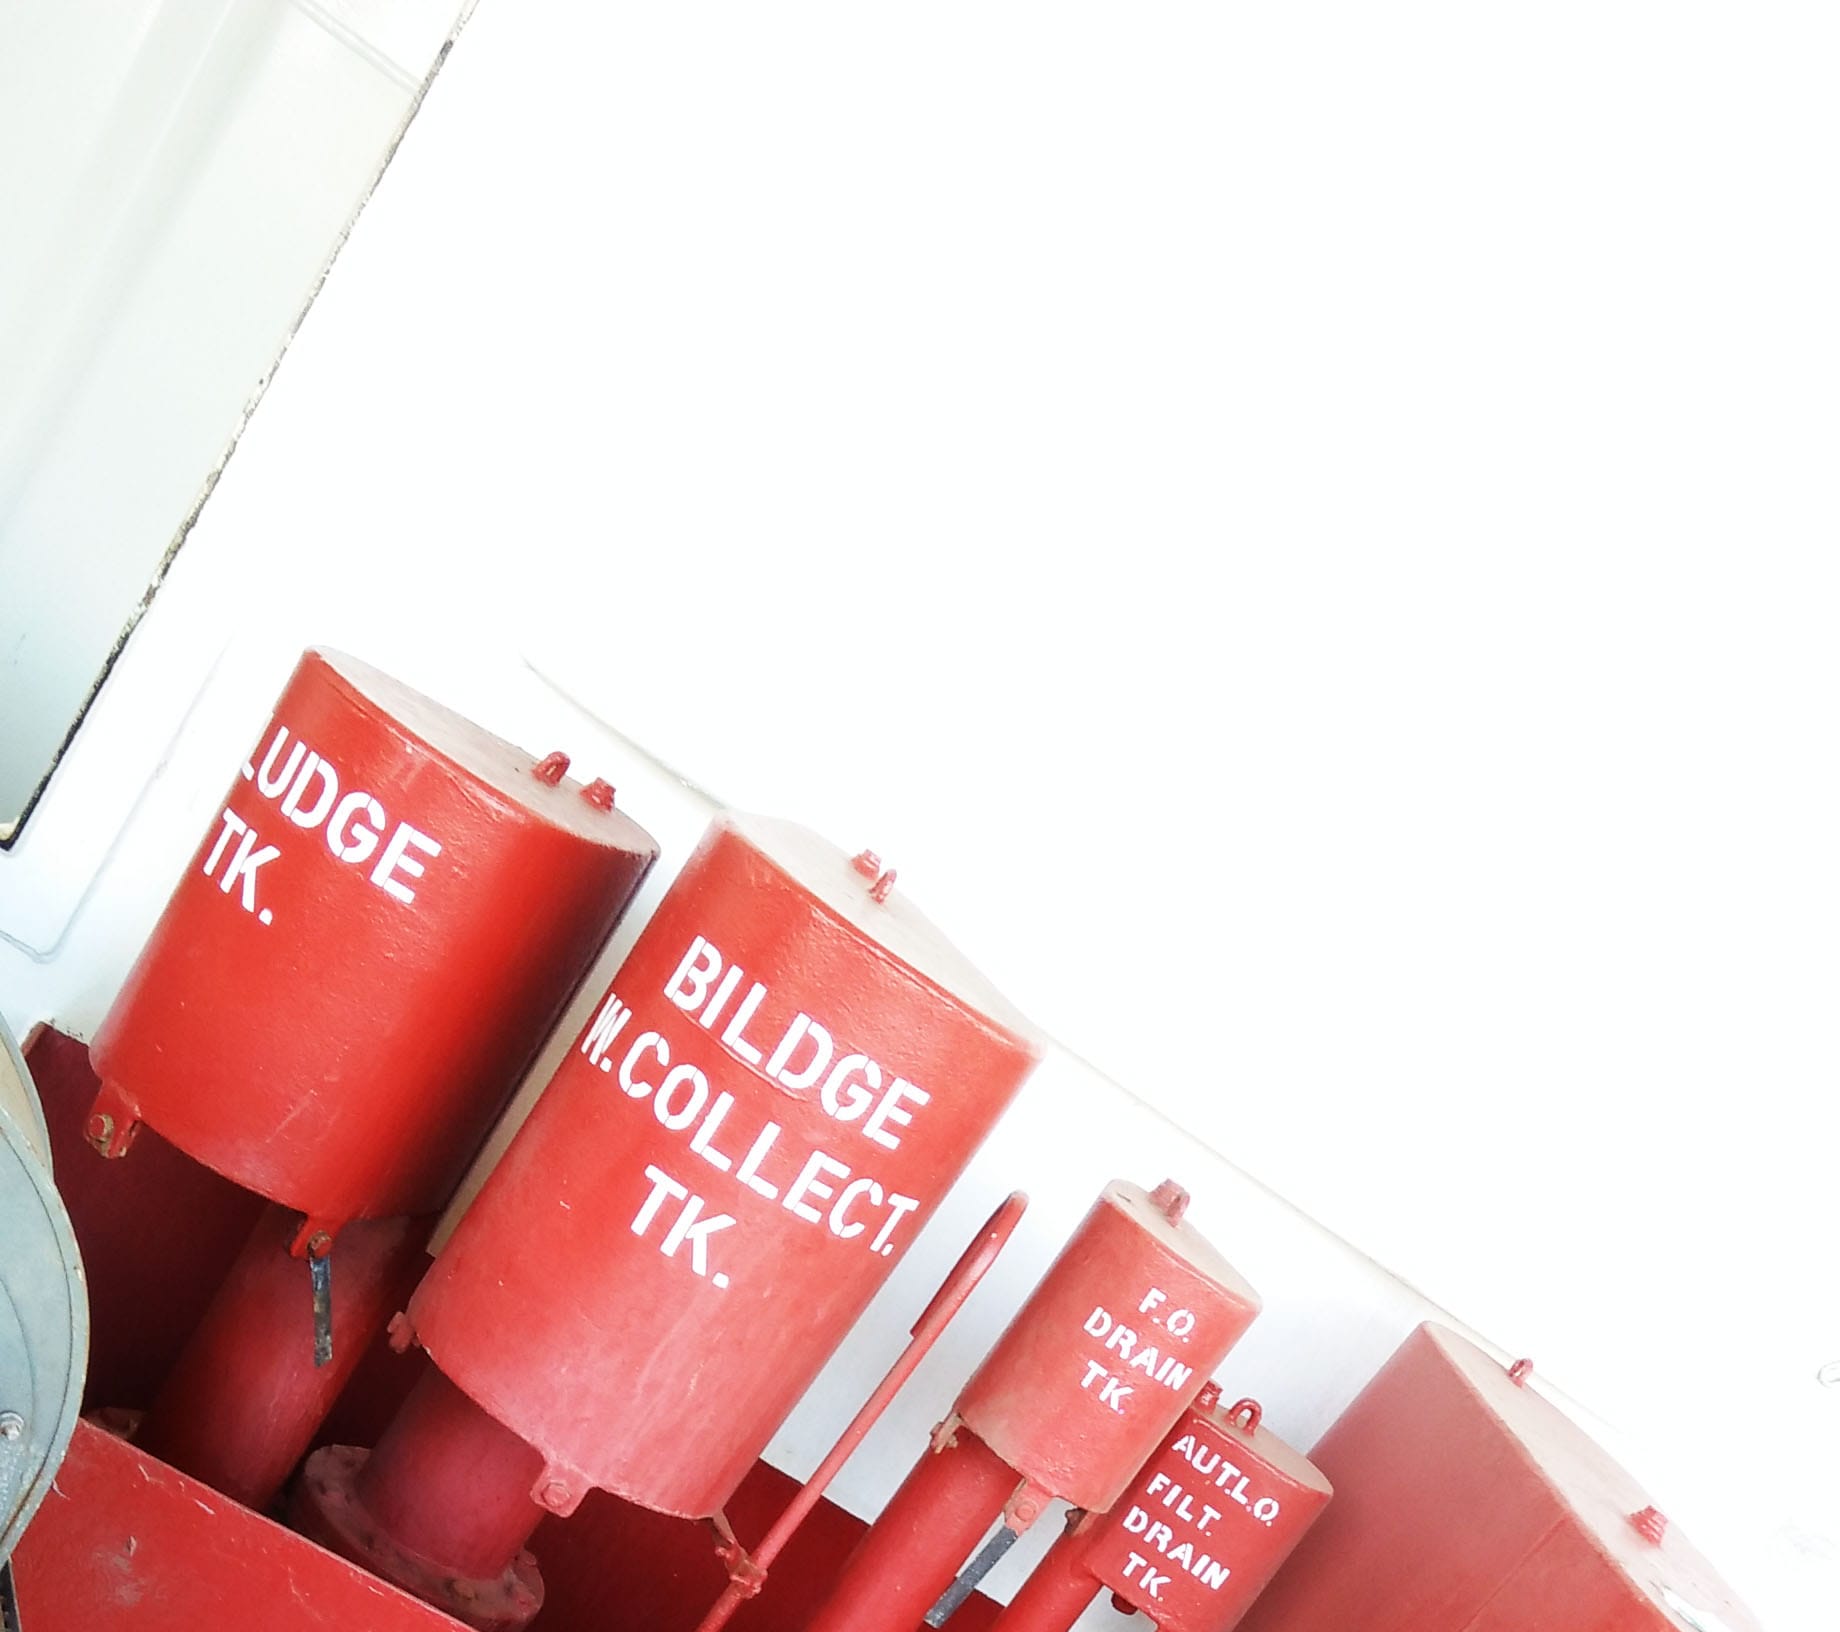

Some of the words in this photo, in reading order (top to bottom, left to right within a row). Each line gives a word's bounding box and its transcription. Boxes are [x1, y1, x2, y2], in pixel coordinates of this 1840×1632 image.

[203, 807, 281, 926] TK.
[239, 726, 442, 905] UDGE
[663, 935, 931, 1150] BILDGE
[630, 1164, 737, 1290] TK.
[1083, 1306, 1193, 1391] DRAIN
[1123, 1506, 1230, 1590] DRAIN
[1146, 1473, 1222, 1537] FILT.
